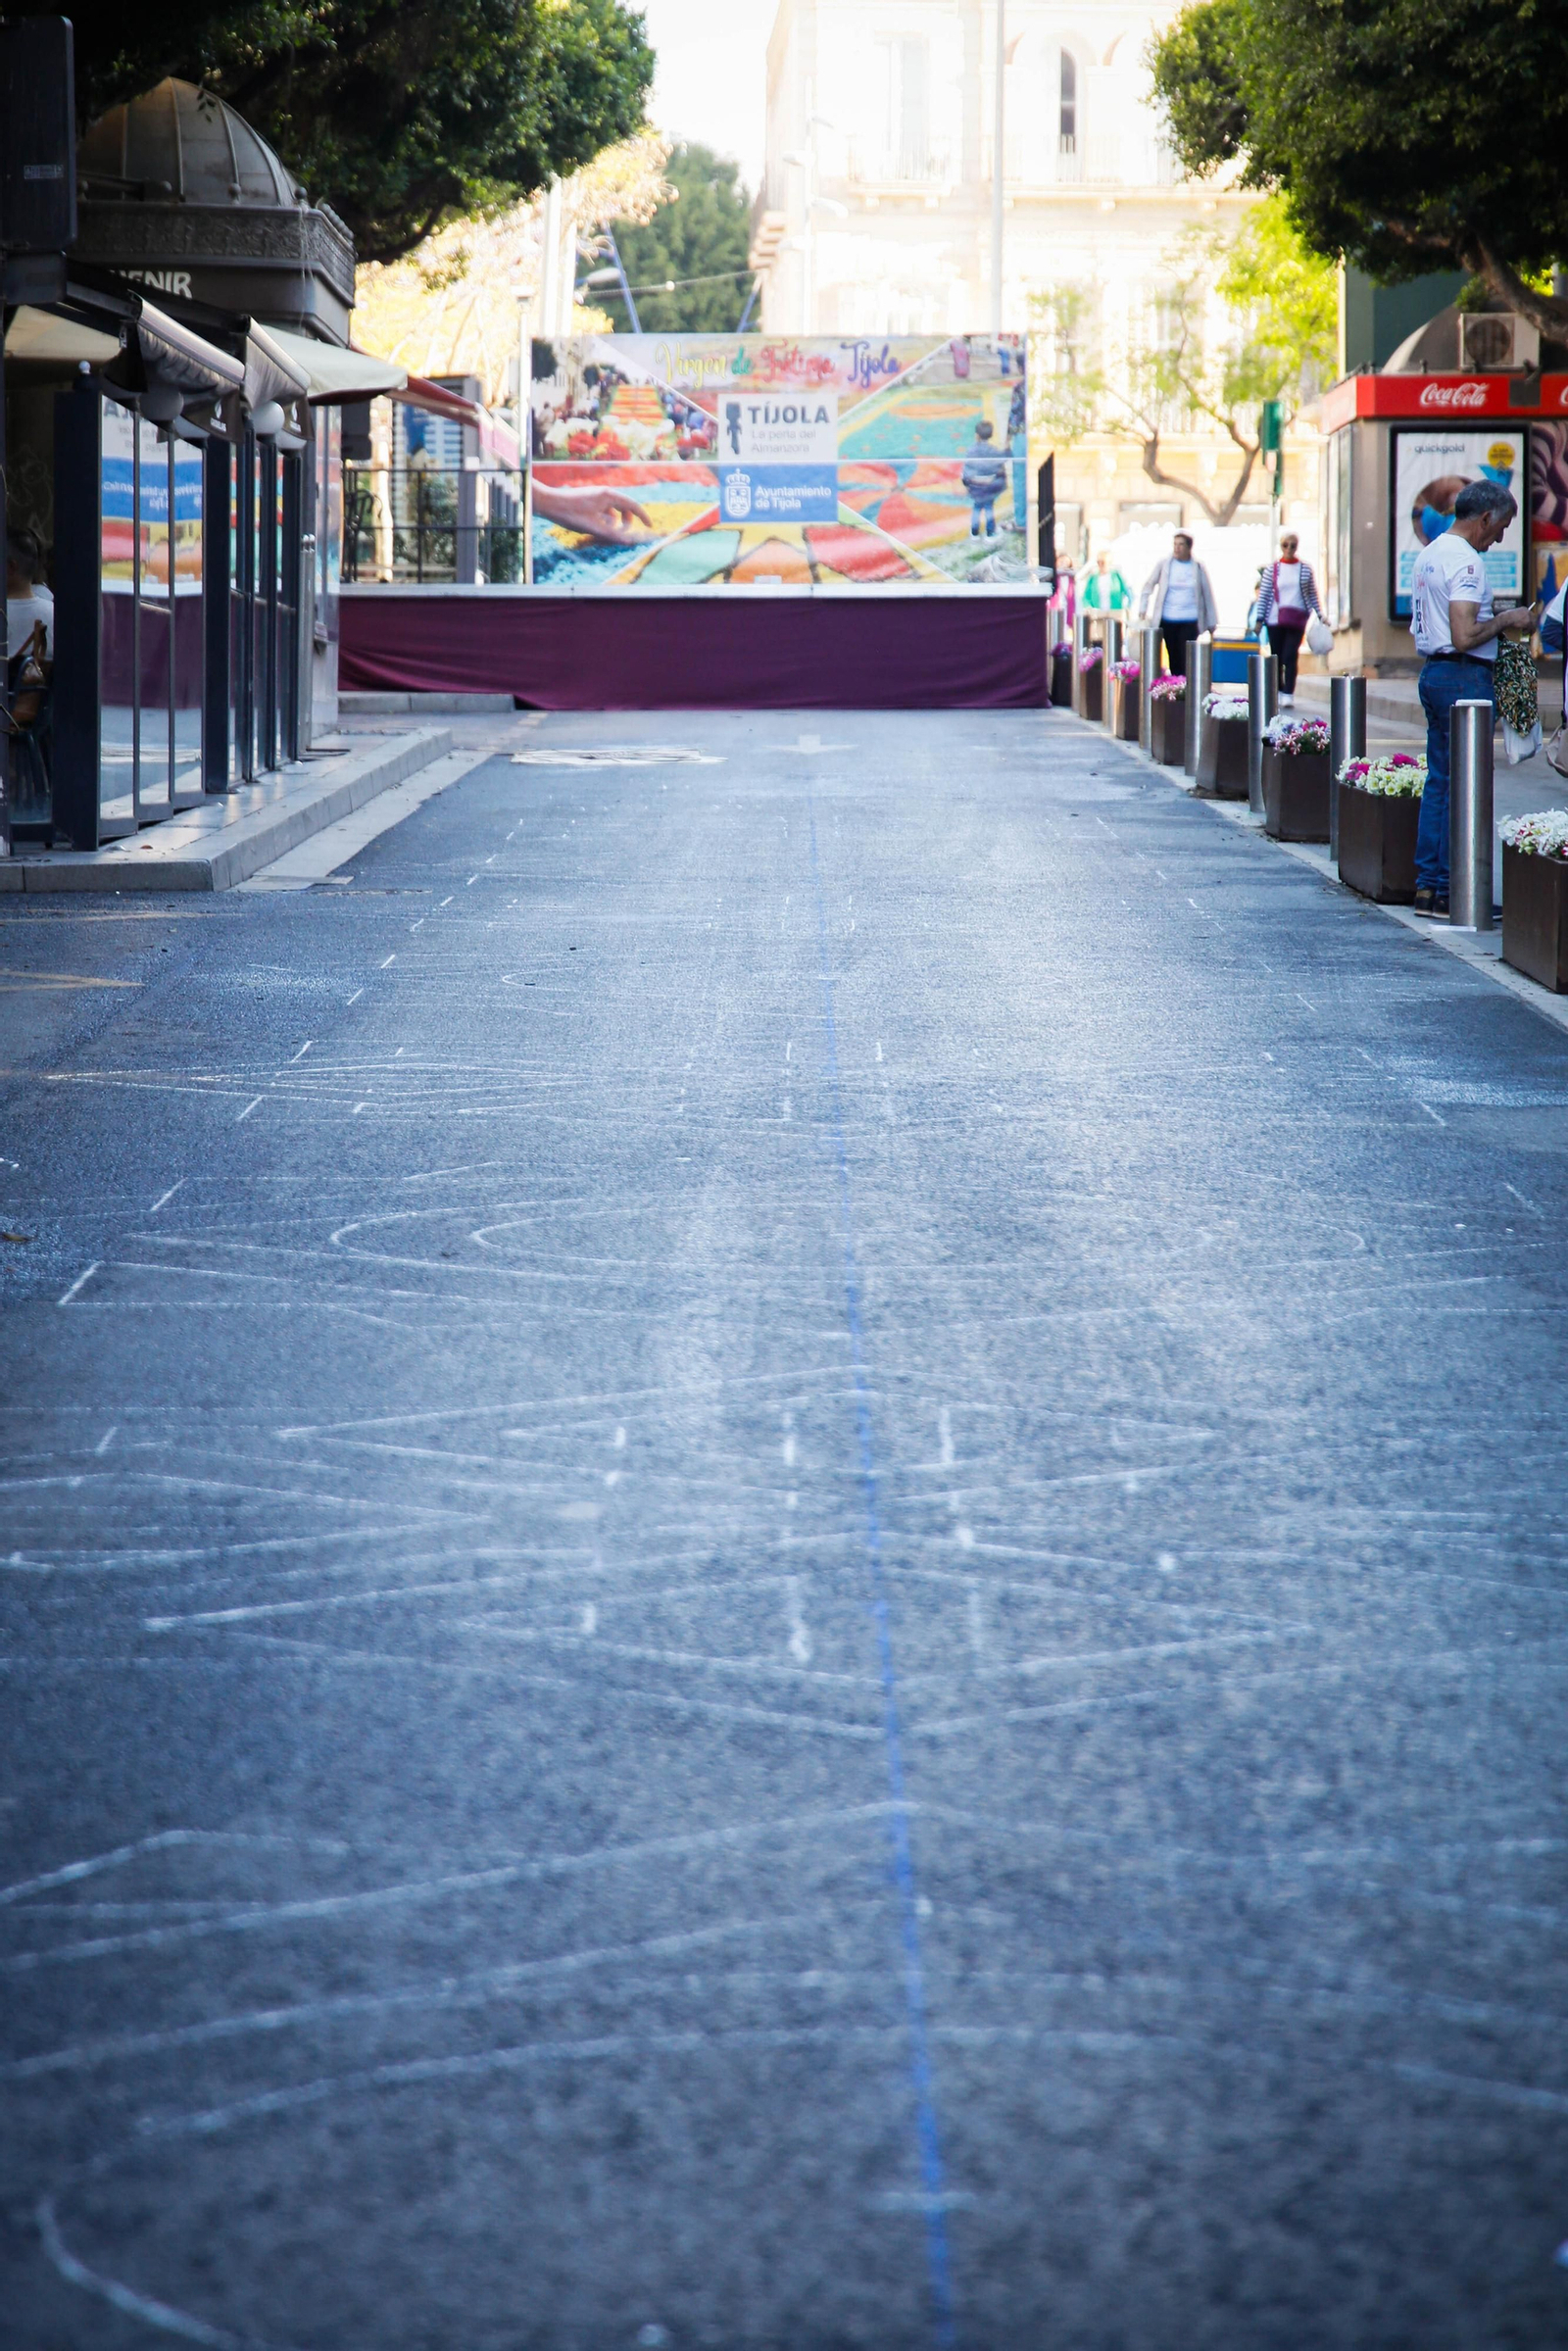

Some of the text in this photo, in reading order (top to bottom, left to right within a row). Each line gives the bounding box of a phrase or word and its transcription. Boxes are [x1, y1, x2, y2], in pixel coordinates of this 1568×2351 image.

[656, 341, 726, 389] Virgen
[731, 345, 753, 374] de
[1420, 382, 1490, 406] Coca-Cola
[748, 401, 830, 424] TÍJOLA
[752, 429, 816, 441] La perla del
[751, 443, 809, 453] Almanzora
[1414, 443, 1465, 454] quickgold
[755, 485, 832, 498] Ayuntamiento
[755, 498, 770, 509] de
